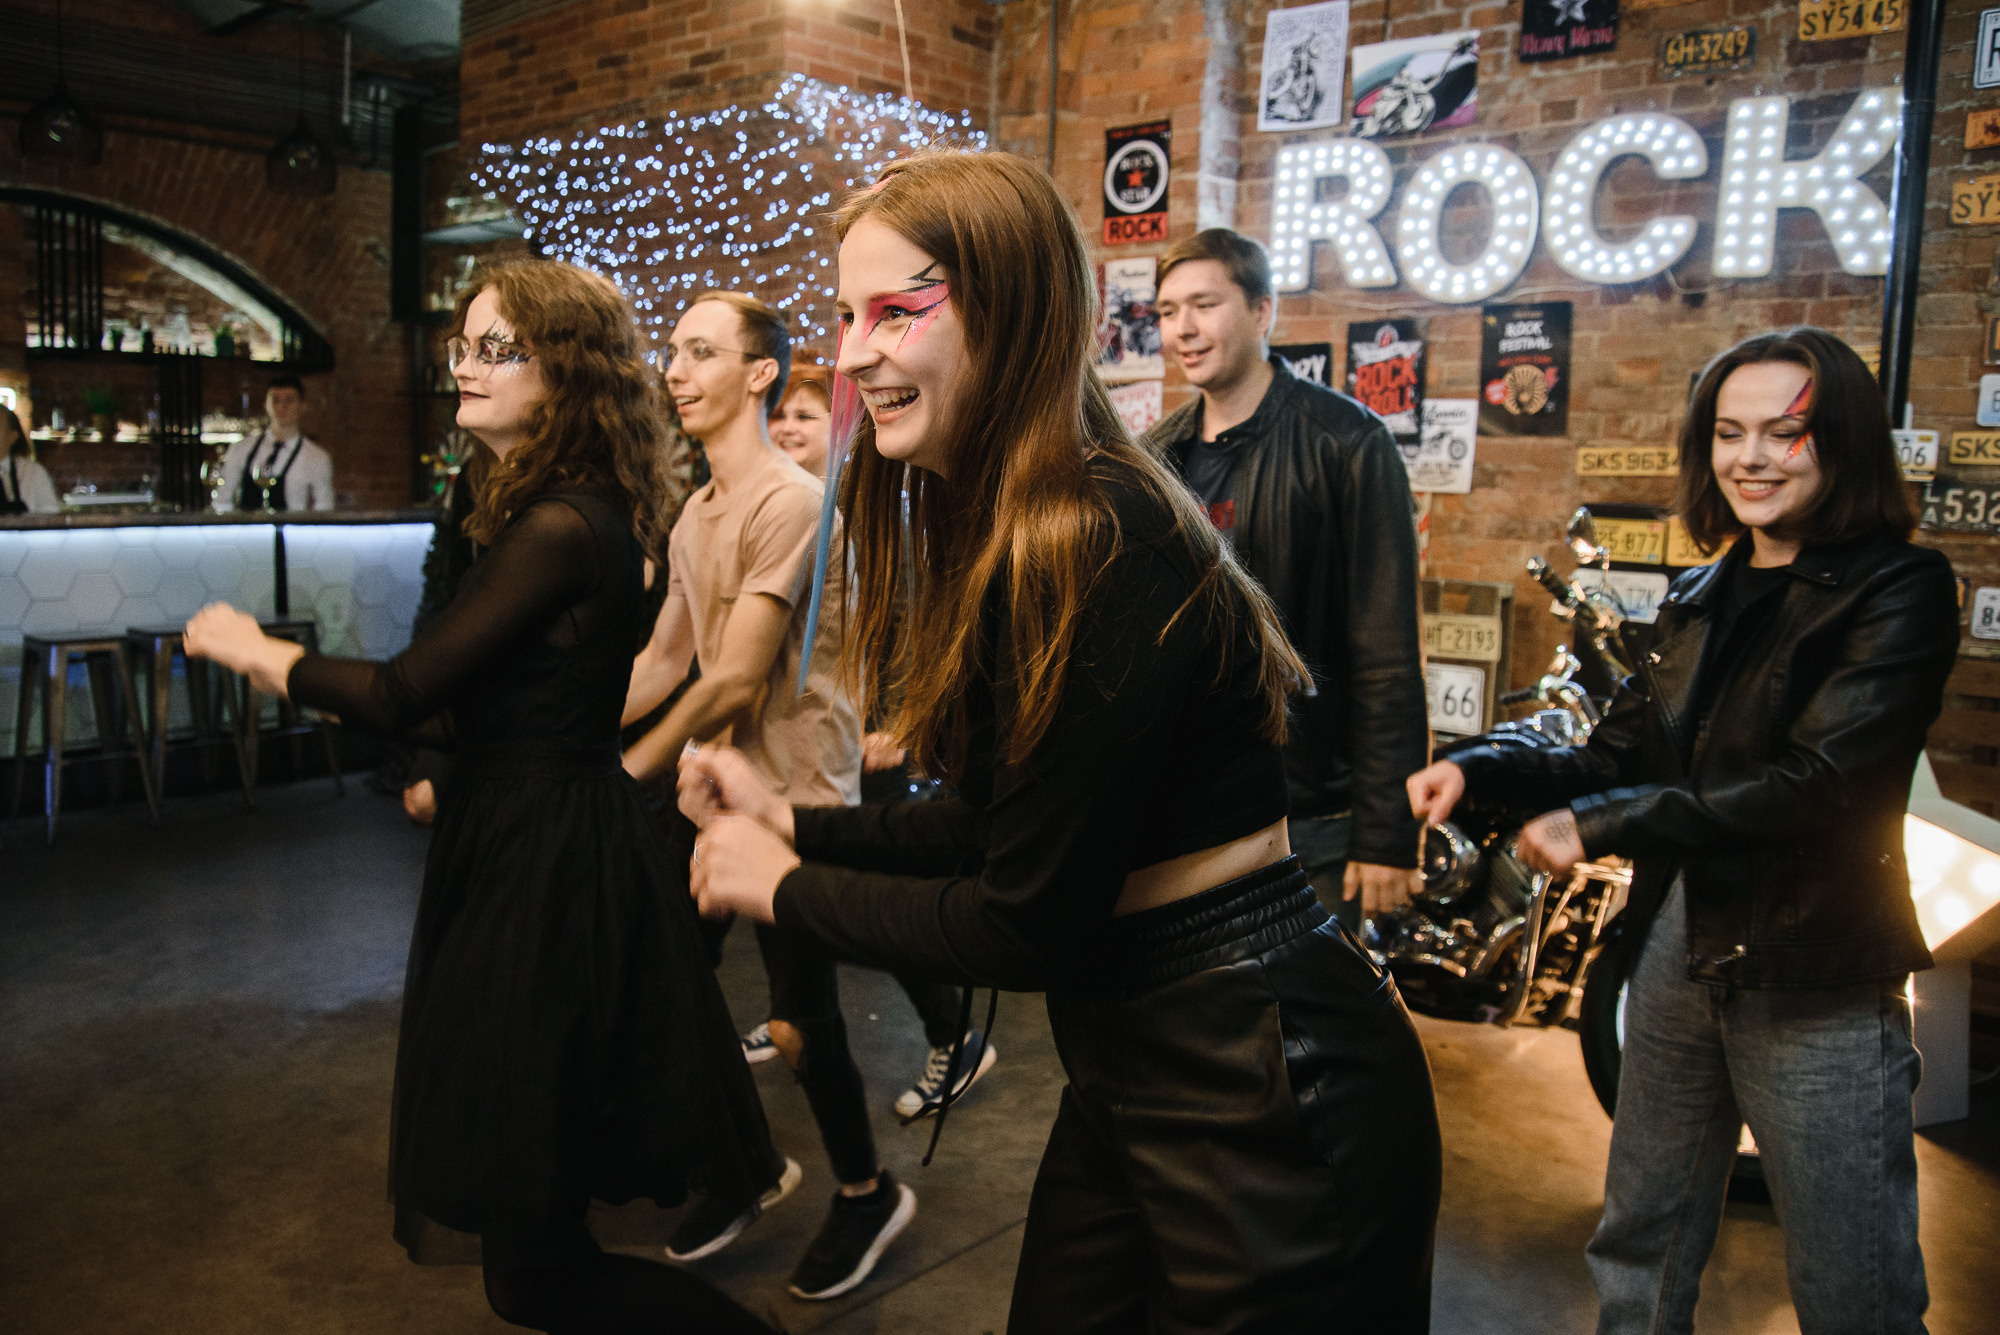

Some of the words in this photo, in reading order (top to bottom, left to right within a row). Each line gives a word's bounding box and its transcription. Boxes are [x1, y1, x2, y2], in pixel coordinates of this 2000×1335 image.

[1270, 86, 1904, 304] ROCK
[1108, 218, 1164, 240] ROCK
[1504, 320, 1544, 338] ROCK
[1499, 336, 1553, 354] FESTIVAL
[1355, 353, 1418, 395] ROCK
[1442, 684, 1475, 718] 66
